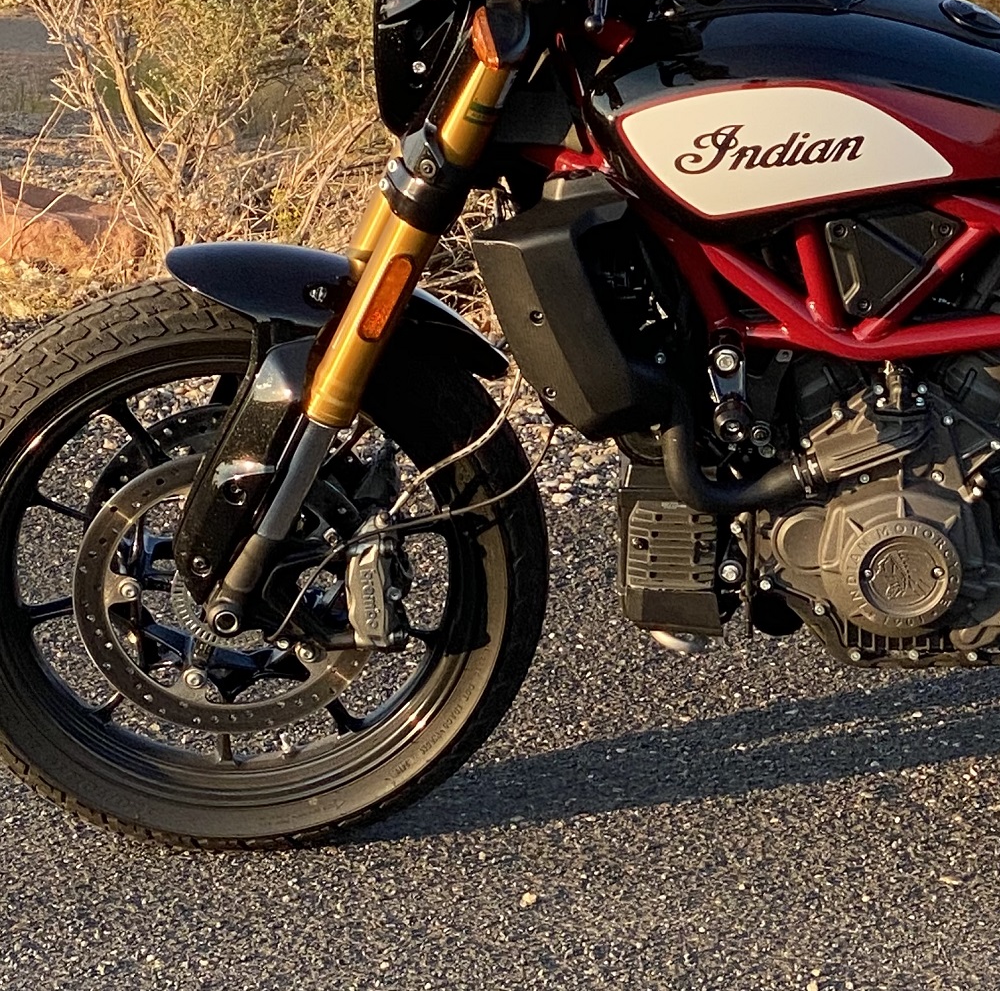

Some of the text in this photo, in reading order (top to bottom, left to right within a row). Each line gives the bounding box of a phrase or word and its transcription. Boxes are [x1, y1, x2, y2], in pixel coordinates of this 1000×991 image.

[674, 124, 865, 175] Indian
[846, 524, 960, 609] INDIAN MOTORCYCLE
[359, 568, 380, 629] brembo
